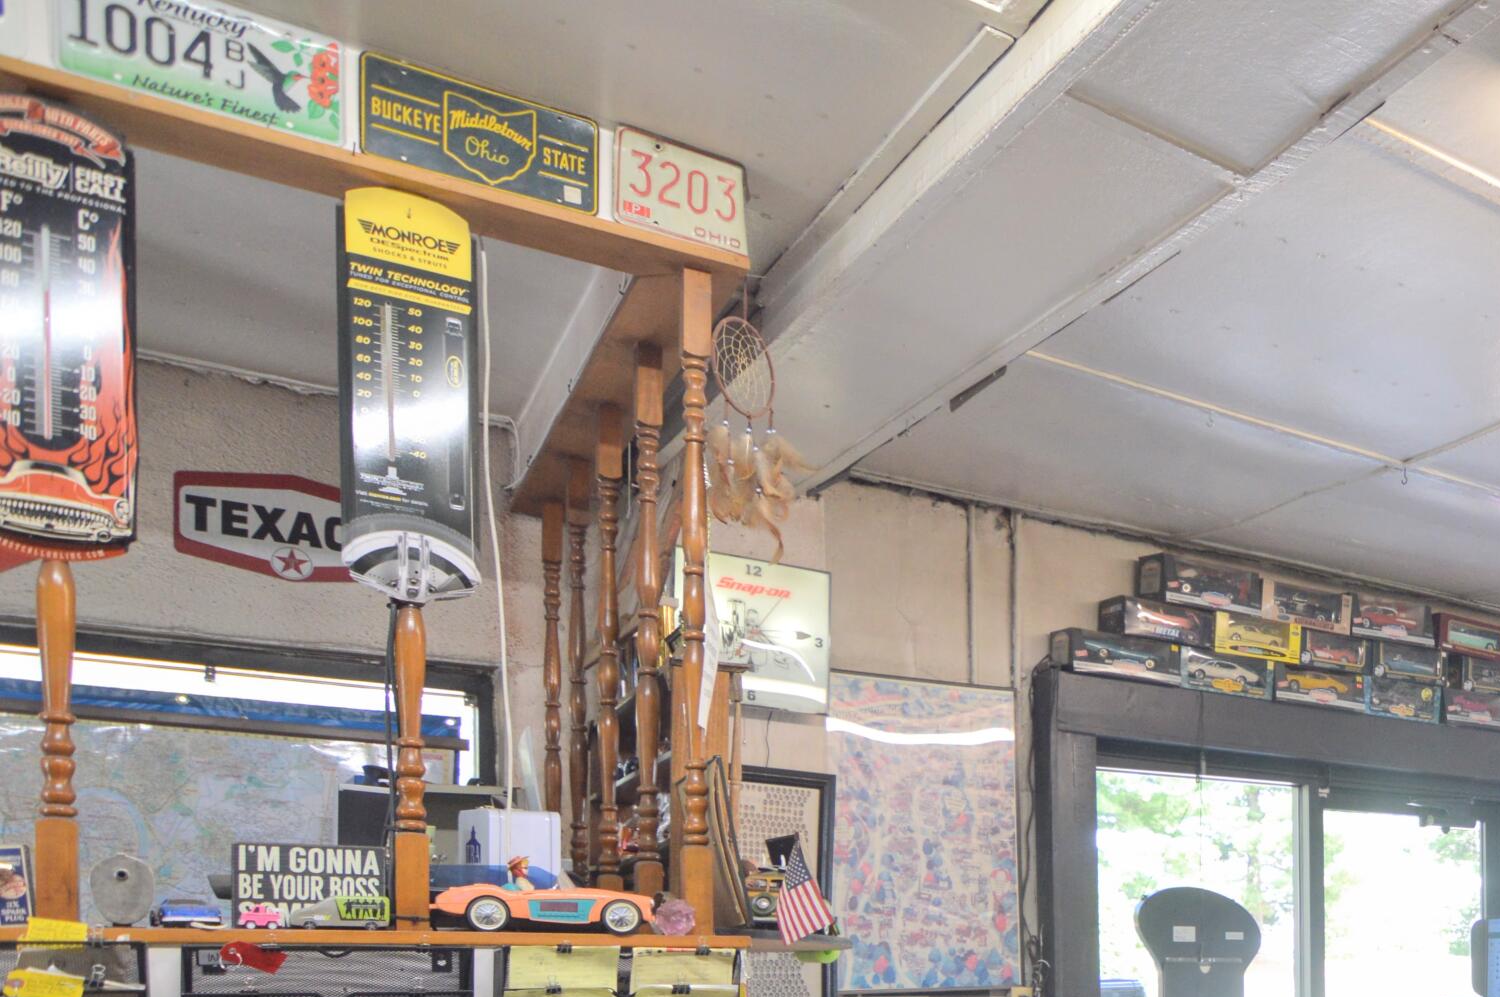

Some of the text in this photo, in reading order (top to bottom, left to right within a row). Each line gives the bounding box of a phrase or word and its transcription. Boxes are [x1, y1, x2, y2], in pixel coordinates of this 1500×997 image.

[131, 73, 278, 127] Nature's Finest
[370, 97, 442, 134] BUCKEYE
[449, 109, 532, 152] Middletown
[465, 136, 510, 166] Ohio
[543, 147, 587, 175] STATE
[75, 166, 126, 189] FIRST
[628, 149, 737, 223] 3203
[75, 180, 126, 204] CALL
[372, 223, 448, 254] MONROE
[694, 226, 741, 249] OHIO
[349, 261, 466, 296] TWIN TECHNOLOGY
[352, 298, 372, 309] 120
[407, 308, 422, 318] 50
[352, 316, 373, 327] 100
[408, 325, 423, 334] 40
[355, 336, 371, 345] 80
[408, 342, 423, 351] 30
[356, 353, 371, 363] 60
[408, 358, 423, 367] 20
[356, 372, 372, 381] 40
[410, 374, 422, 383] 10
[356, 389, 372, 398] 20
[185, 494, 342, 553] TEXAC
[745, 564, 762, 577] 12
[716, 576, 792, 599] Snap-on
[815, 638, 824, 649] 3
[747, 690, 756, 701] 6
[238, 844, 381, 876] I'M GONNA
[238, 873, 380, 901] BE YOUR BOSS
